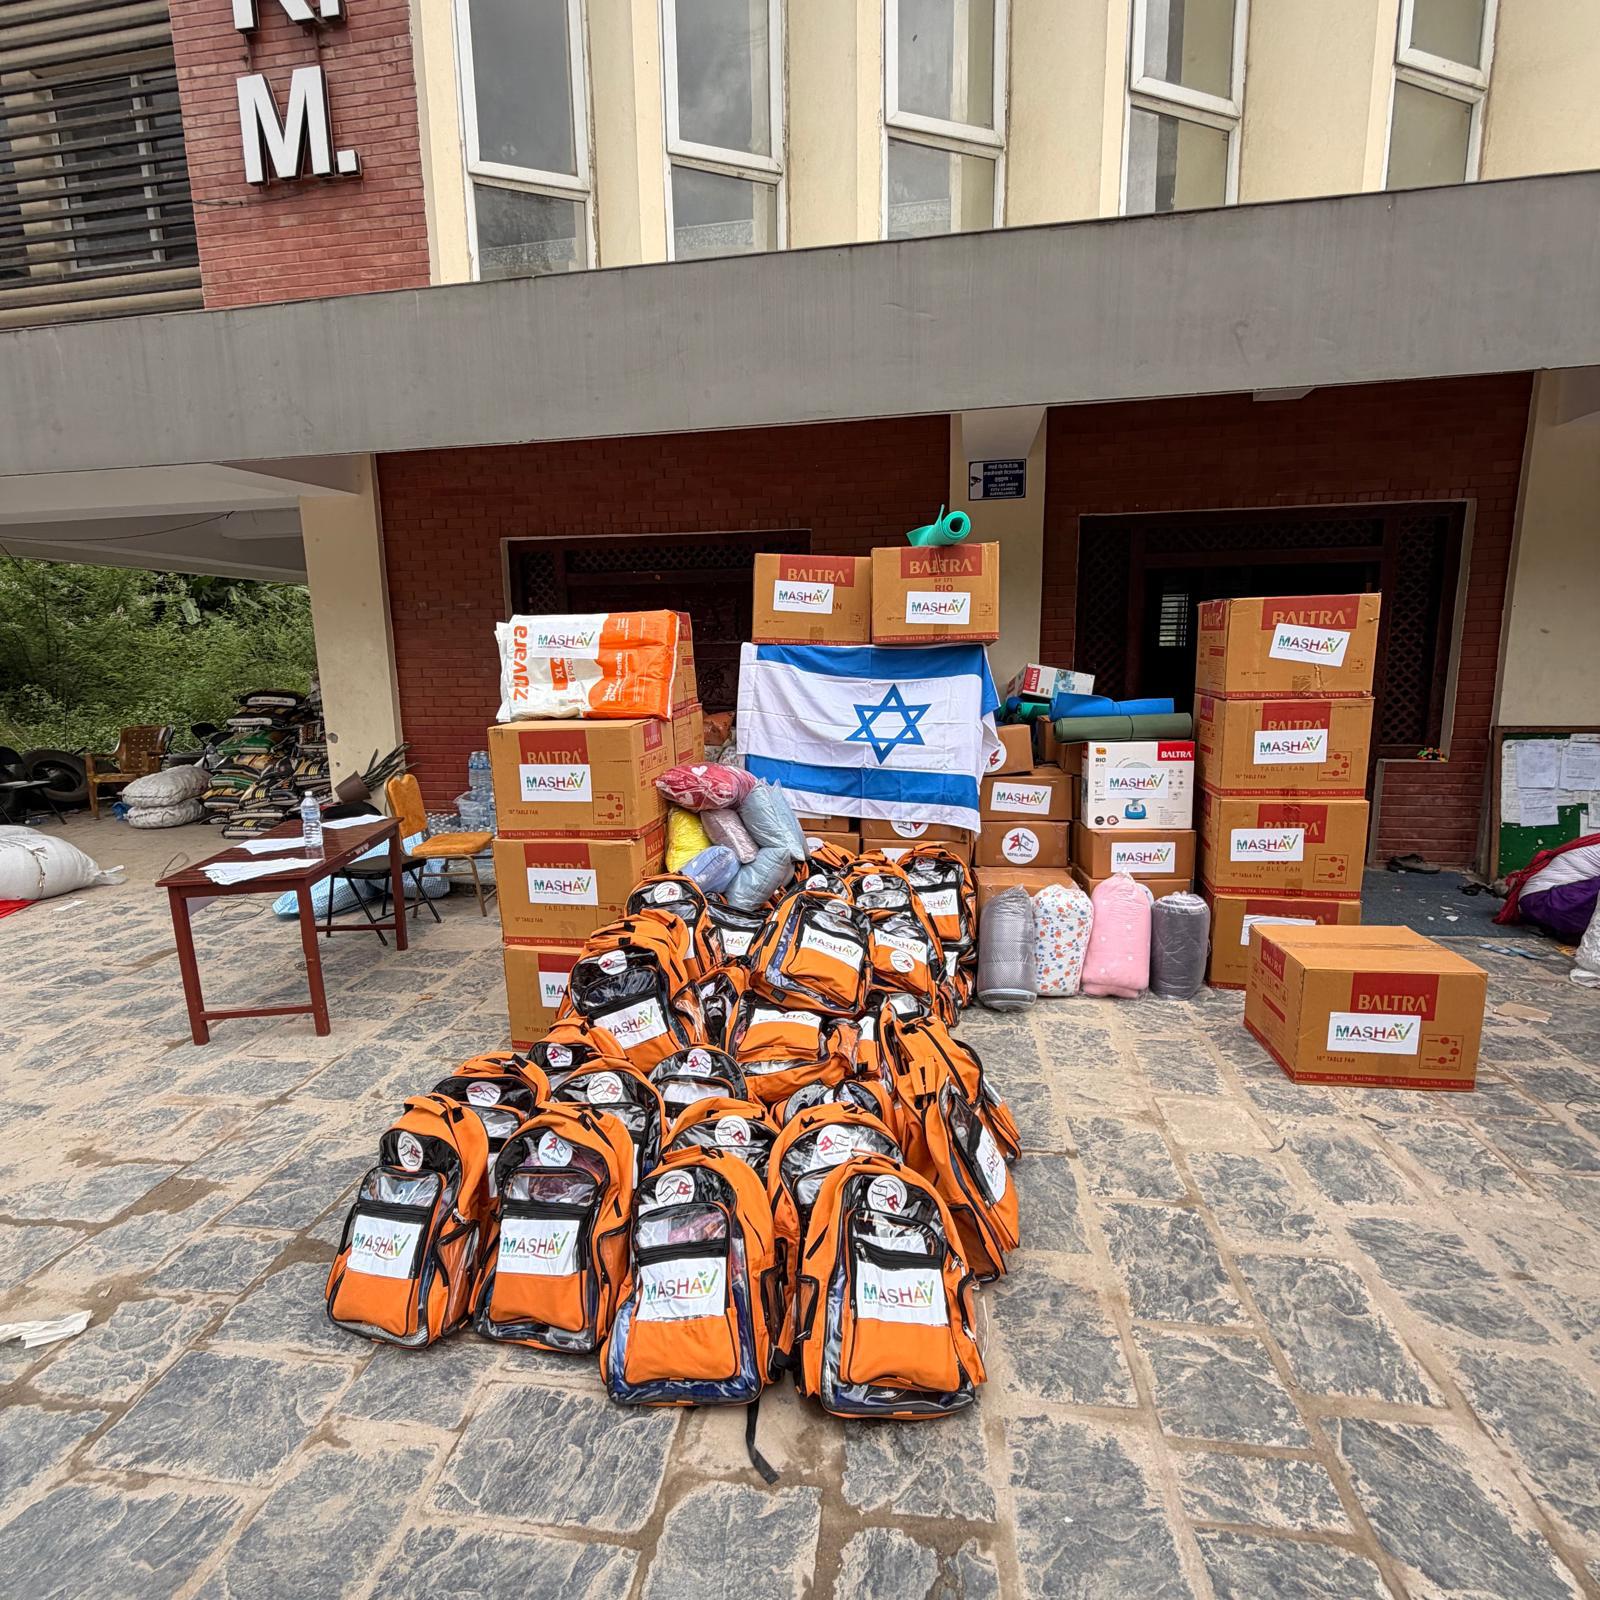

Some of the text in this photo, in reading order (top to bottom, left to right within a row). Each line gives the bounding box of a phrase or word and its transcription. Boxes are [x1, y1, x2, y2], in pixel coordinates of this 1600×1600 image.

[236, 65, 360, 185] M.
[787, 568, 846, 583] BALTRA
[909, 559, 973, 574] BALTRA
[778, 589, 830, 604] MASHAV
[934, 584, 954, 592] RIO
[911, 598, 966, 614] MASHAV
[1272, 610, 1346, 625] BALTRA
[537, 631, 596, 648] MASHAV
[1278, 635, 1344, 654] MASHAV
[513, 625, 529, 701] zuvara
[1259, 735, 1322, 754] MASHAV
[1160, 750, 1192, 758] BALTRA
[526, 771, 586, 789] MASHAV
[1109, 774, 1165, 789] MASHAV
[996, 791, 1048, 805] MASHAV
[1236, 834, 1299, 852] MASHAV
[1116, 848, 1172, 862] MASHAV
[534, 876, 592, 894] MASHAV
[808, 935, 859, 957] MASHAV
[1358, 994, 1428, 1012] BALTRA
[1335, 1022, 1414, 1043] MASHAV
[353, 1234, 412, 1259] MASHAV
[502, 1230, 570, 1258] MASHAV
[644, 1268, 718, 1301] MASHAV
[863, 1280, 934, 1306] MASHAV
